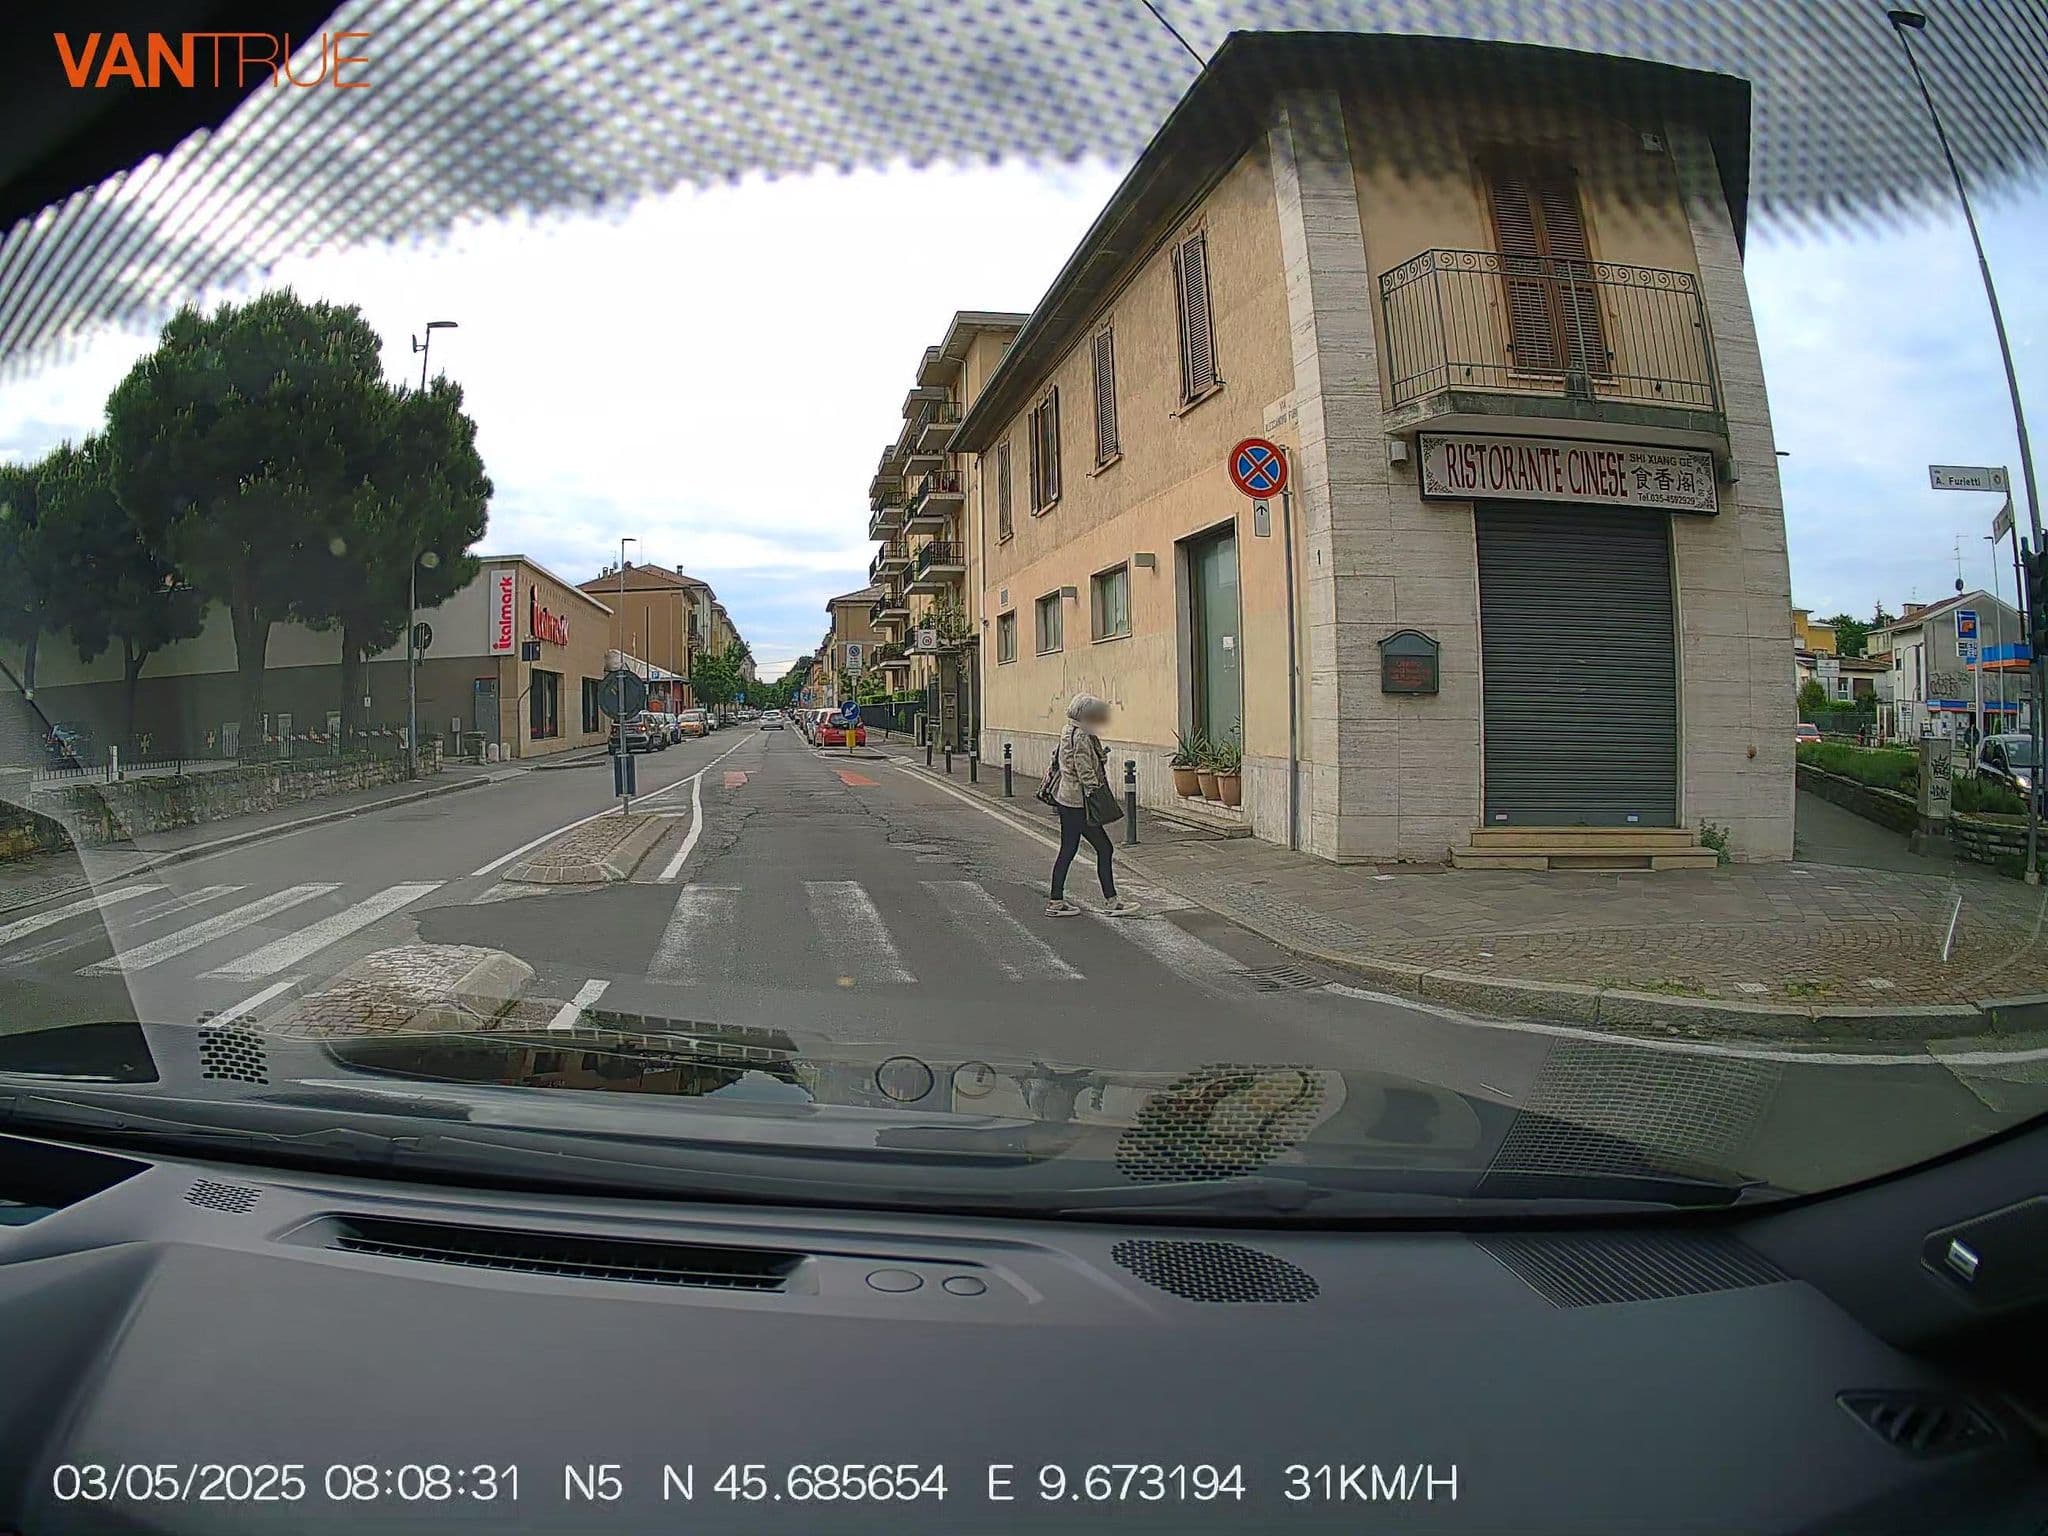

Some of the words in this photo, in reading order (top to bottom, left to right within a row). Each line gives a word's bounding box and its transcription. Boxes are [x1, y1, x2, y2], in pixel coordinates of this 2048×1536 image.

[1445, 443, 1563, 493] RISTORANTE
[1567, 448, 1628, 498] CINESE
[1630, 453, 1646, 463] SHI
[1647, 454, 1677, 467] XIANG
[1631, 465, 1696, 494] 食香阁
[492, 576, 513, 650] italmark
